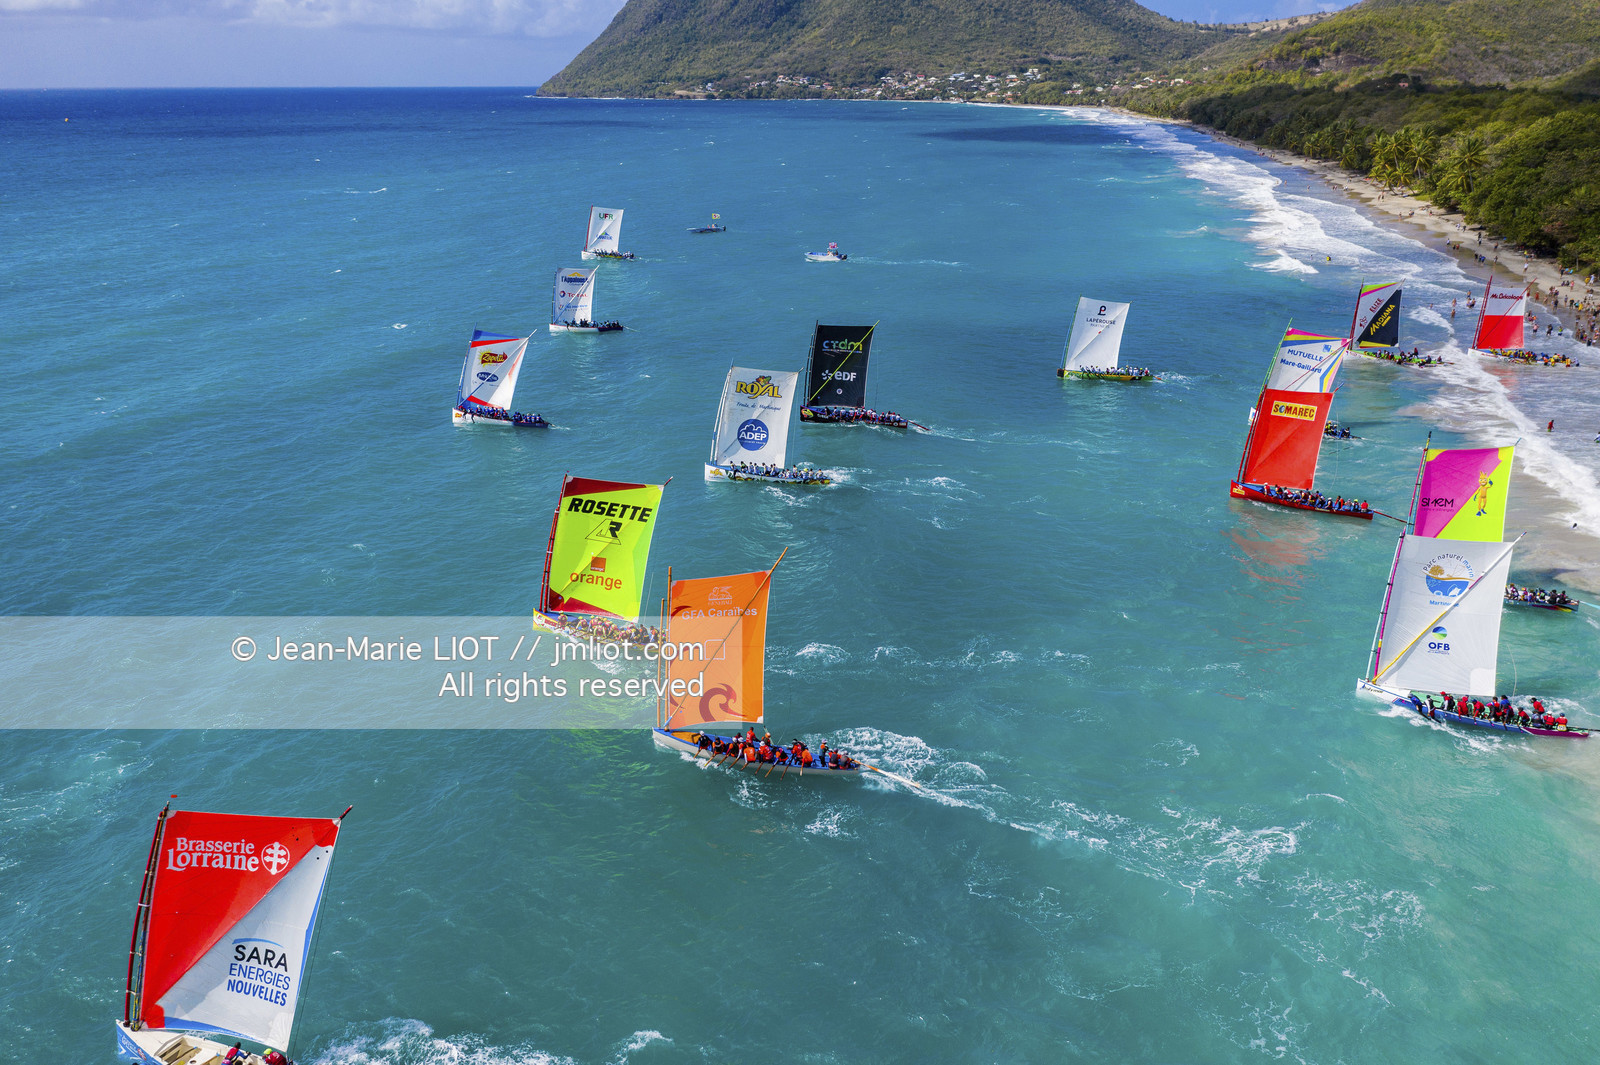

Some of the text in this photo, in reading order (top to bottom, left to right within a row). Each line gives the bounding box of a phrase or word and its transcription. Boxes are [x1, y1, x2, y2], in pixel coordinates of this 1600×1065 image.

[598, 212, 614, 220] UFR
[1370, 304, 1396, 336] MADIANA
[1287, 349, 1324, 362] MUTUELLE
[1280, 358, 1323, 374] Mare-Gaillard
[735, 381, 783, 399] ROYAL
[1273, 404, 1315, 418] SOMAREC
[738, 431, 767, 441] ADEP
[567, 497, 653, 523] ROSETTE
[1422, 552, 1475, 578] Parc naturel marin
[570, 572, 622, 591] orange
[681, 606, 758, 620] GFA Caraïbes
[1428, 642, 1450, 651] OFB
[175, 836, 256, 855] Brasserie
[166, 847, 260, 873] Lorraine
[233, 944, 289, 973] SARA
[229, 963, 292, 991] ENERGIES
[226, 978, 288, 1008] NOUVELLES
